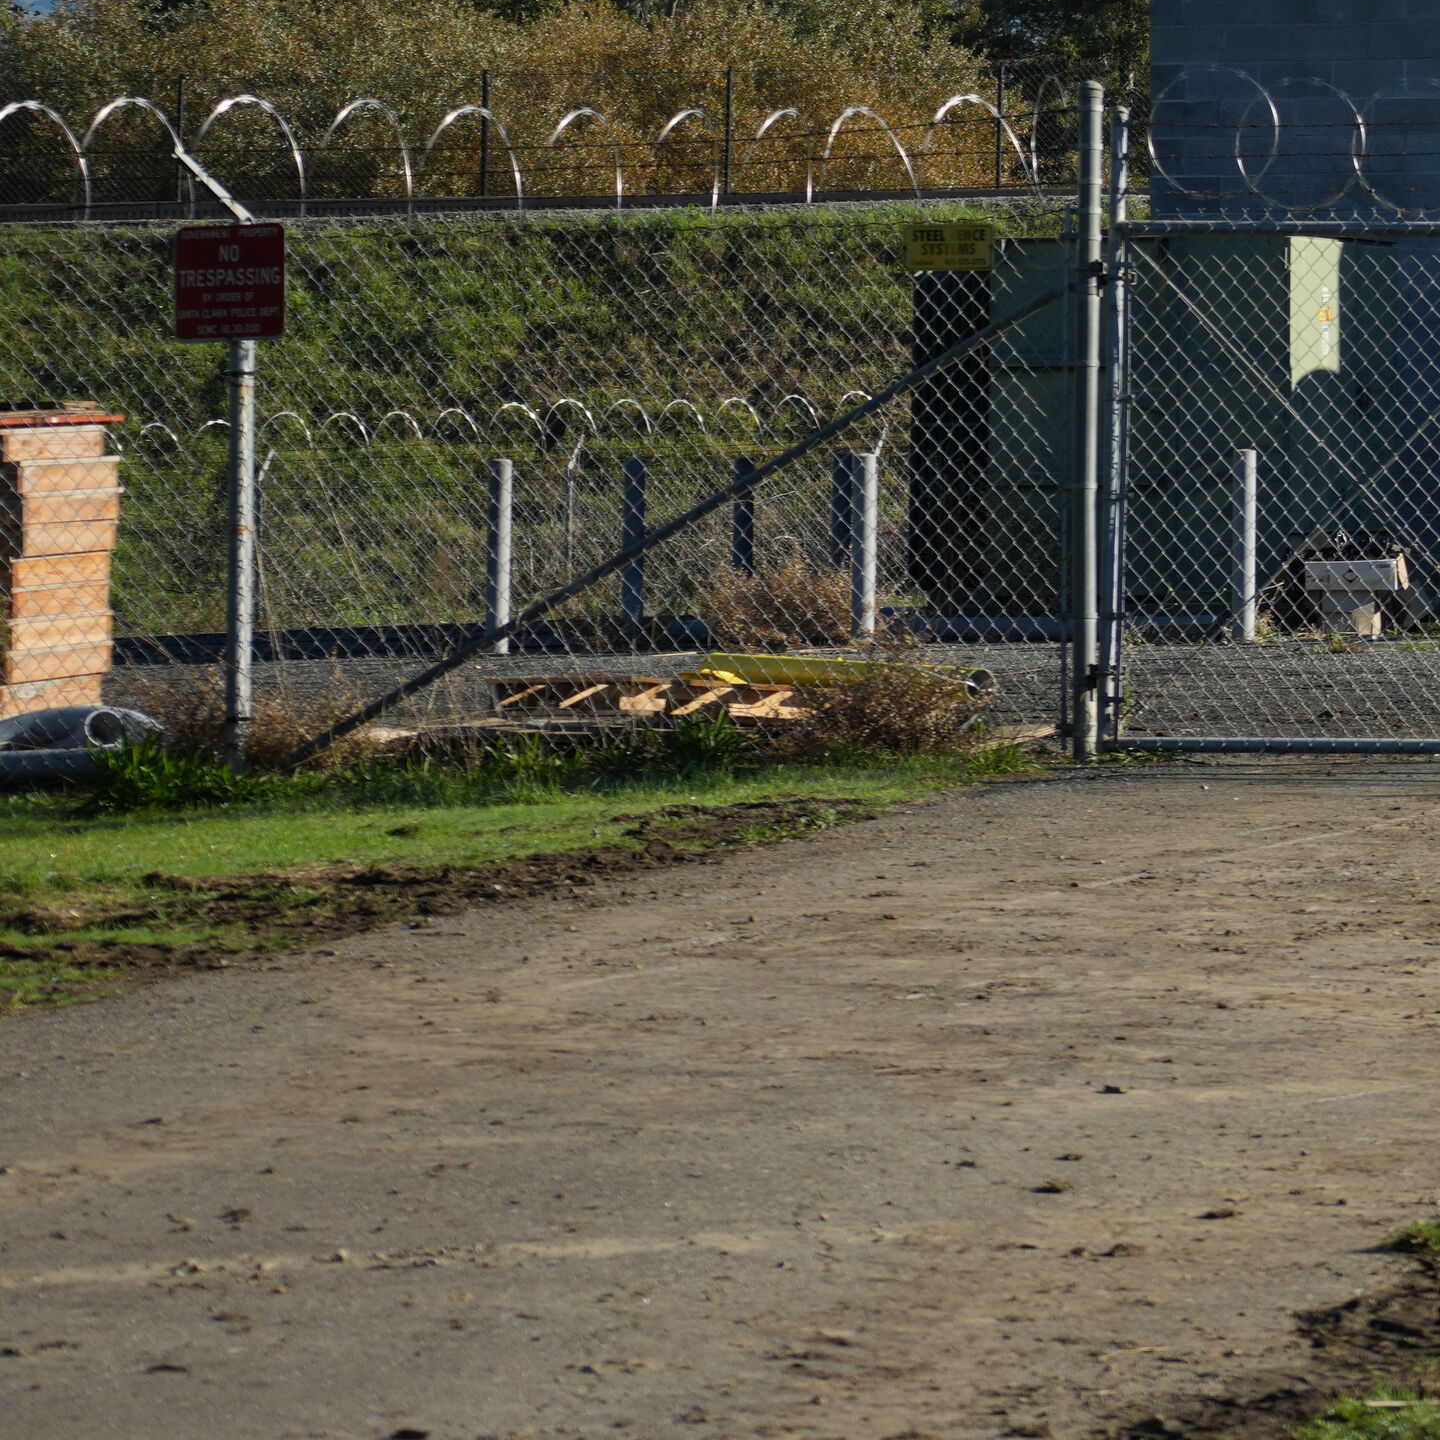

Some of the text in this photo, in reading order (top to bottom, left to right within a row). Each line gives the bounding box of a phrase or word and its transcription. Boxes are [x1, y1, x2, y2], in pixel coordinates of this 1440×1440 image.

[181, 227, 278, 240] GOVERNMENT PROPERTY
[912, 229, 985, 242] STEEL ENCE
[218, 244, 240, 263] NO
[921, 243, 976, 256] SYSTMS
[178, 266, 281, 288] TRESPASSING
[201, 291, 256, 303] BY ORDER OF
[230, 307, 257, 318] POLICE
